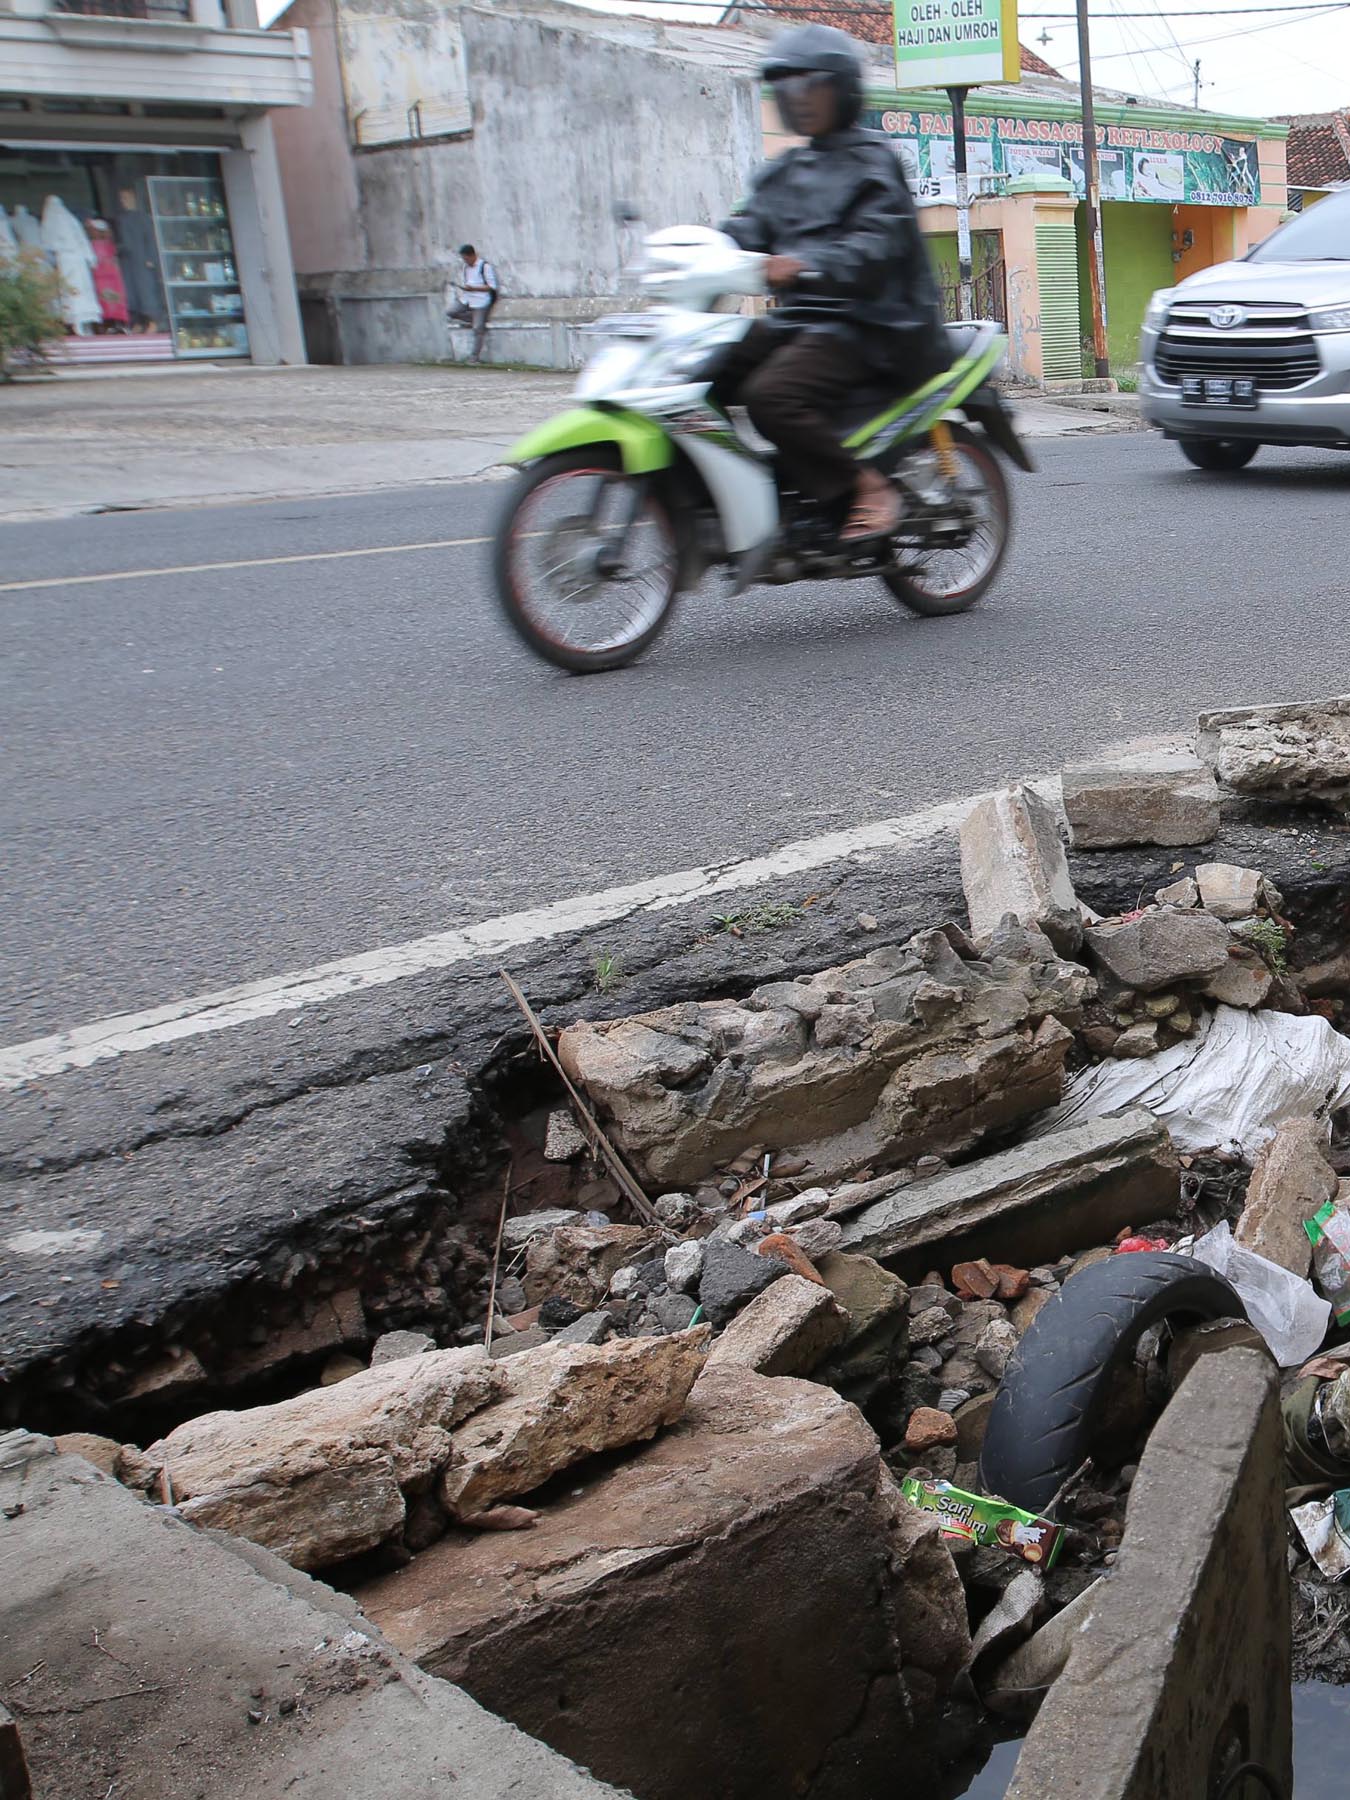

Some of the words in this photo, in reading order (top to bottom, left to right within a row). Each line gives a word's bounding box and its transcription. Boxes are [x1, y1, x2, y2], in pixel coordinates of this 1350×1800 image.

[910, 3, 941, 22] OLEH
[951, 0, 983, 17] OLEH
[898, 29, 924, 46] HAJI
[927, 26, 951, 43] DAN
[954, 21, 998, 40] UMROH
[1107, 127, 1224, 154] REFLEXOLOGY
[1191, 191, 1211, 201] 0812
[936, 1496, 975, 1517] Sari
[921, 1504, 988, 1535] ndum
